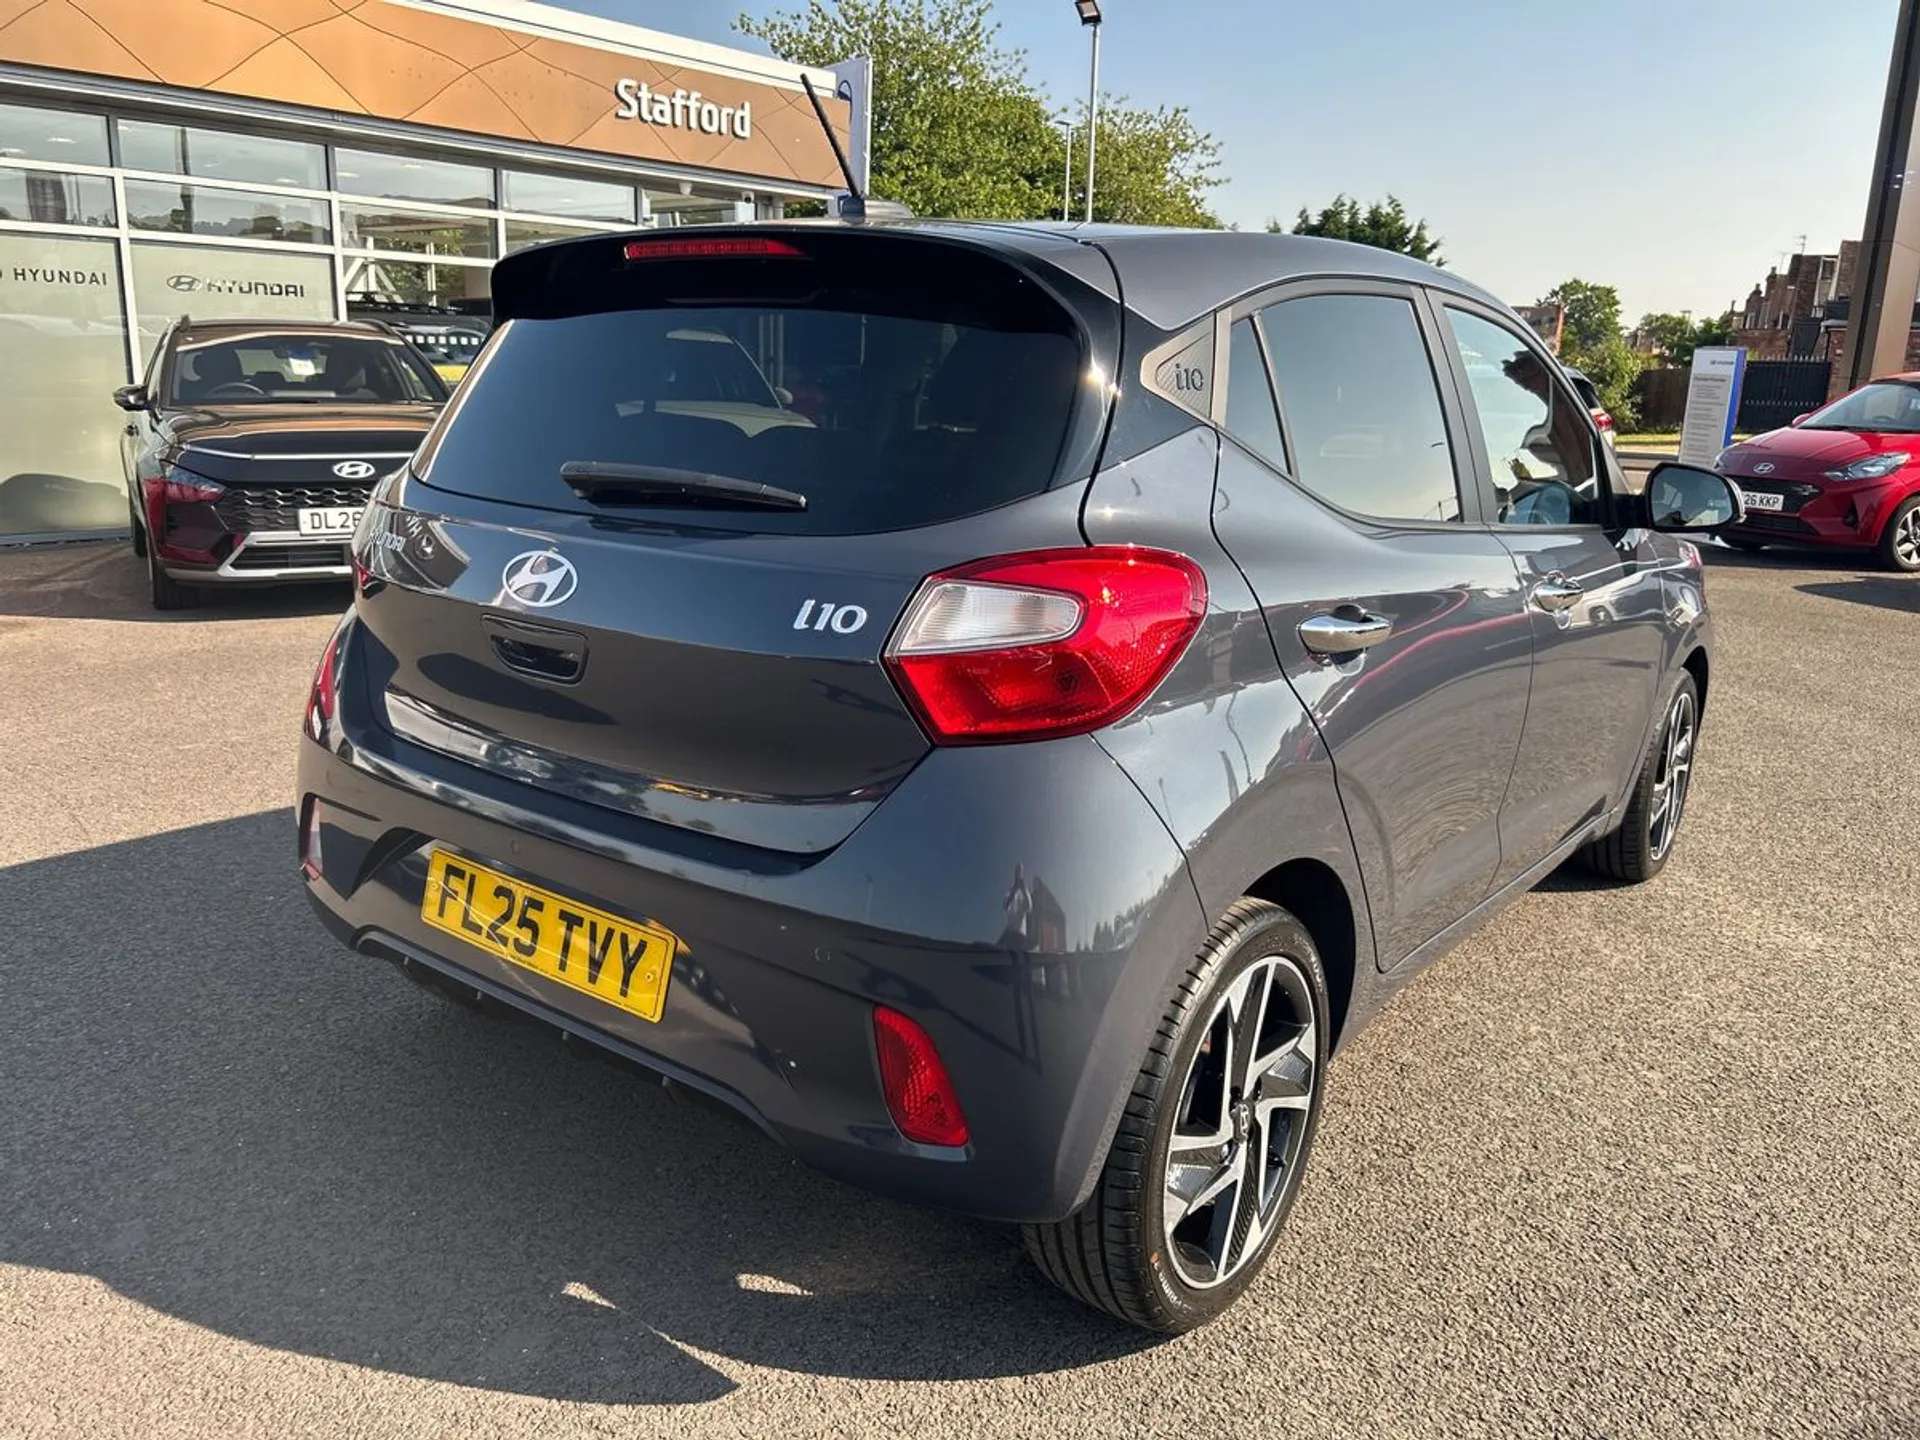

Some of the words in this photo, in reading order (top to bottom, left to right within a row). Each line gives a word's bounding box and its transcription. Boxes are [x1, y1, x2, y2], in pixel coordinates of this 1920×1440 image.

[615, 78, 751, 139] Stafford
[13, 267, 107, 286] HYUNDAI
[207, 280, 304, 298] HYUNDAI
[1175, 363, 1204, 392] i10
[1743, 494, 1757, 506] 26
[1758, 496, 1780, 508] KKP
[438, 863, 545, 958] FL25
[558, 908, 648, 998] TVY
